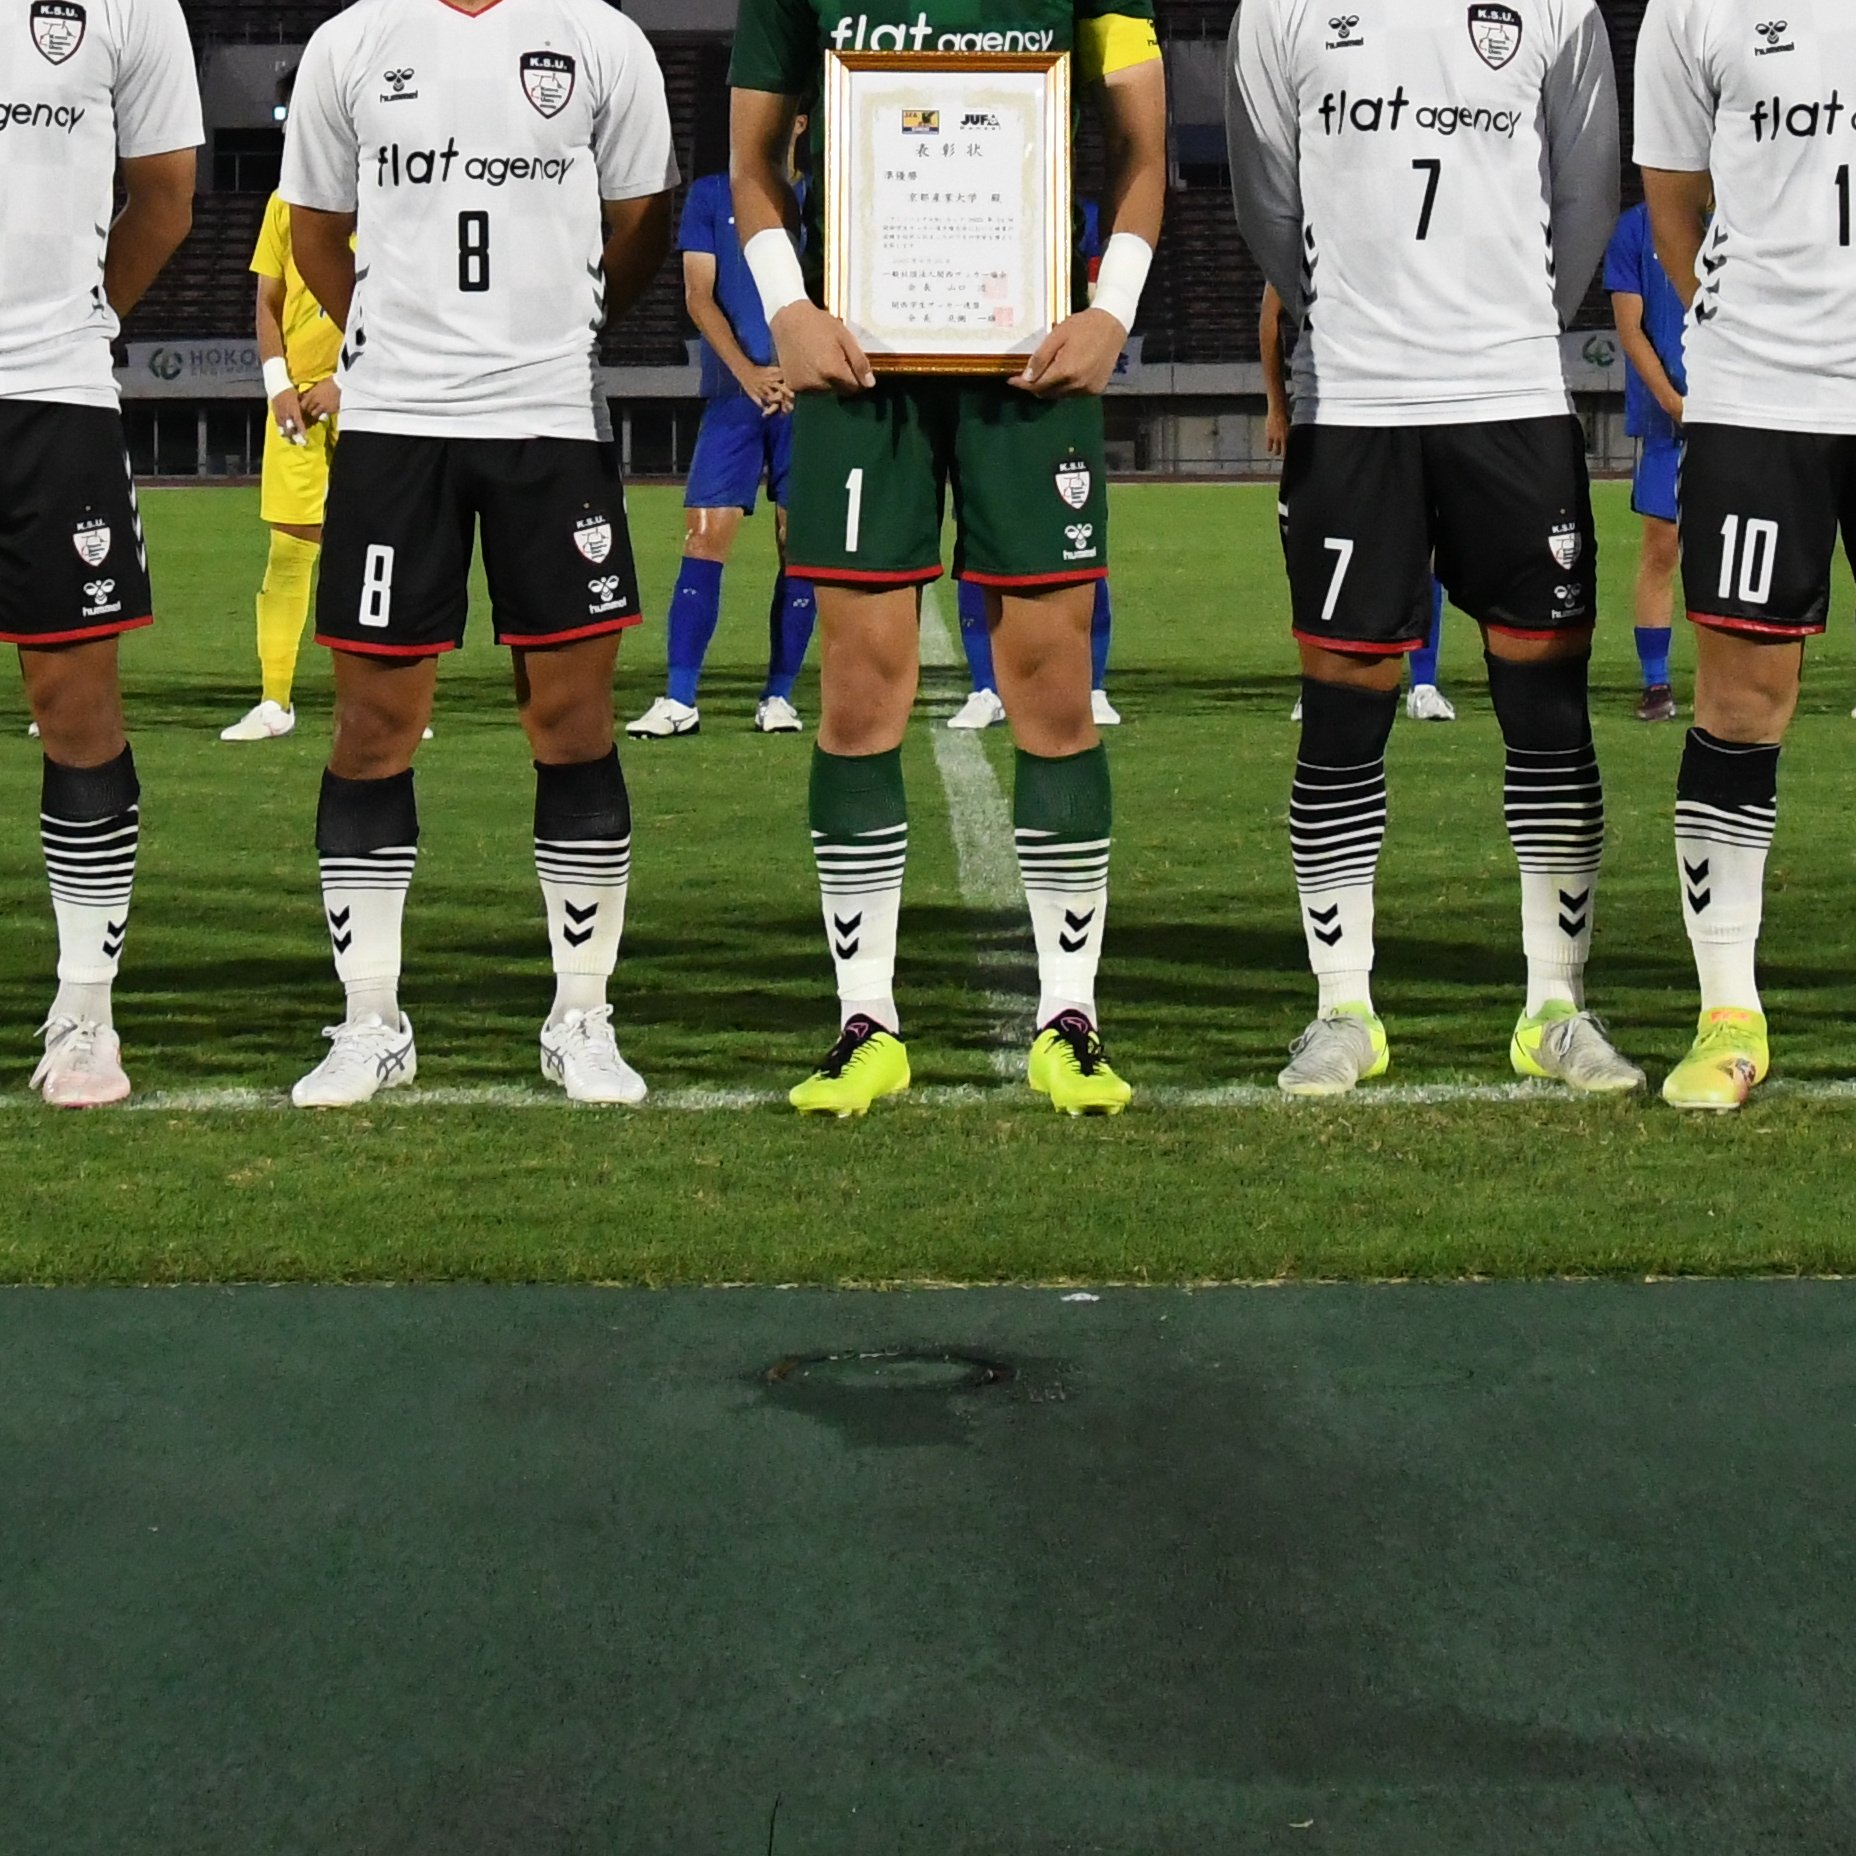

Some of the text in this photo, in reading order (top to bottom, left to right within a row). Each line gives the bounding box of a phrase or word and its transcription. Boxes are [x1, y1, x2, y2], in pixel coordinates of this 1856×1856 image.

[40, 5, 78, 17] K.S.U.
[831, 12, 1053, 51] flat agency
[1477, 8, 1516, 23] K.S.U.
[529, 57, 568, 71] K.S.U.
[1318, 86, 1522, 139] flat agency
[1750, 89, 1844, 142] flat
[377, 137, 574, 187] flat agency
[1412, 159, 1441, 240] 7
[458, 210, 489, 292] 8
[845, 468, 863, 552] 1
[1551, 521, 1576, 534] K.S.U
[1321, 537, 1354, 621] 7
[1718, 513, 1779, 604] 10
[359, 543, 394, 628] 8
